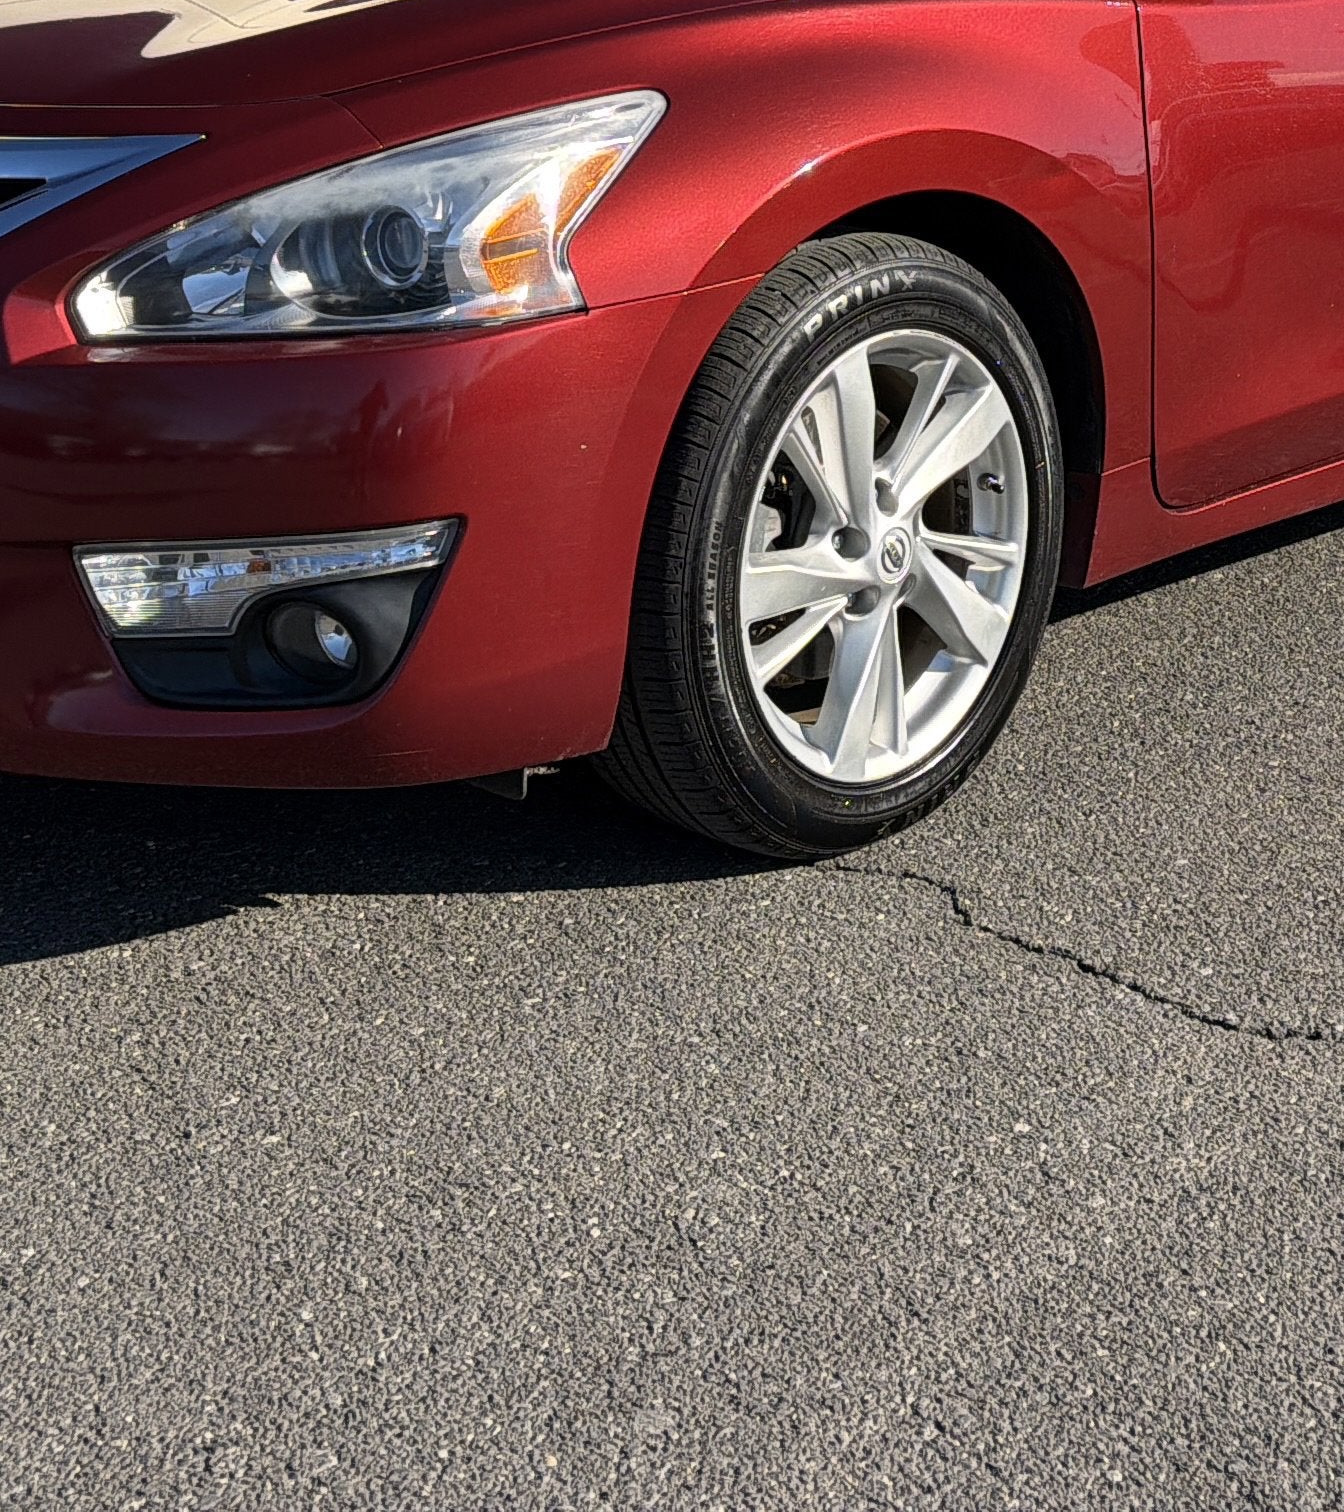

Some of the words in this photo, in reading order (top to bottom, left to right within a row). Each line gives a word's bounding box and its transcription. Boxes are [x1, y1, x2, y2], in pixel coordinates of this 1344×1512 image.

[802, 269, 918, 340] PRINX
[708, 520, 723, 581] SEASON
[705, 585, 715, 611] ALL
